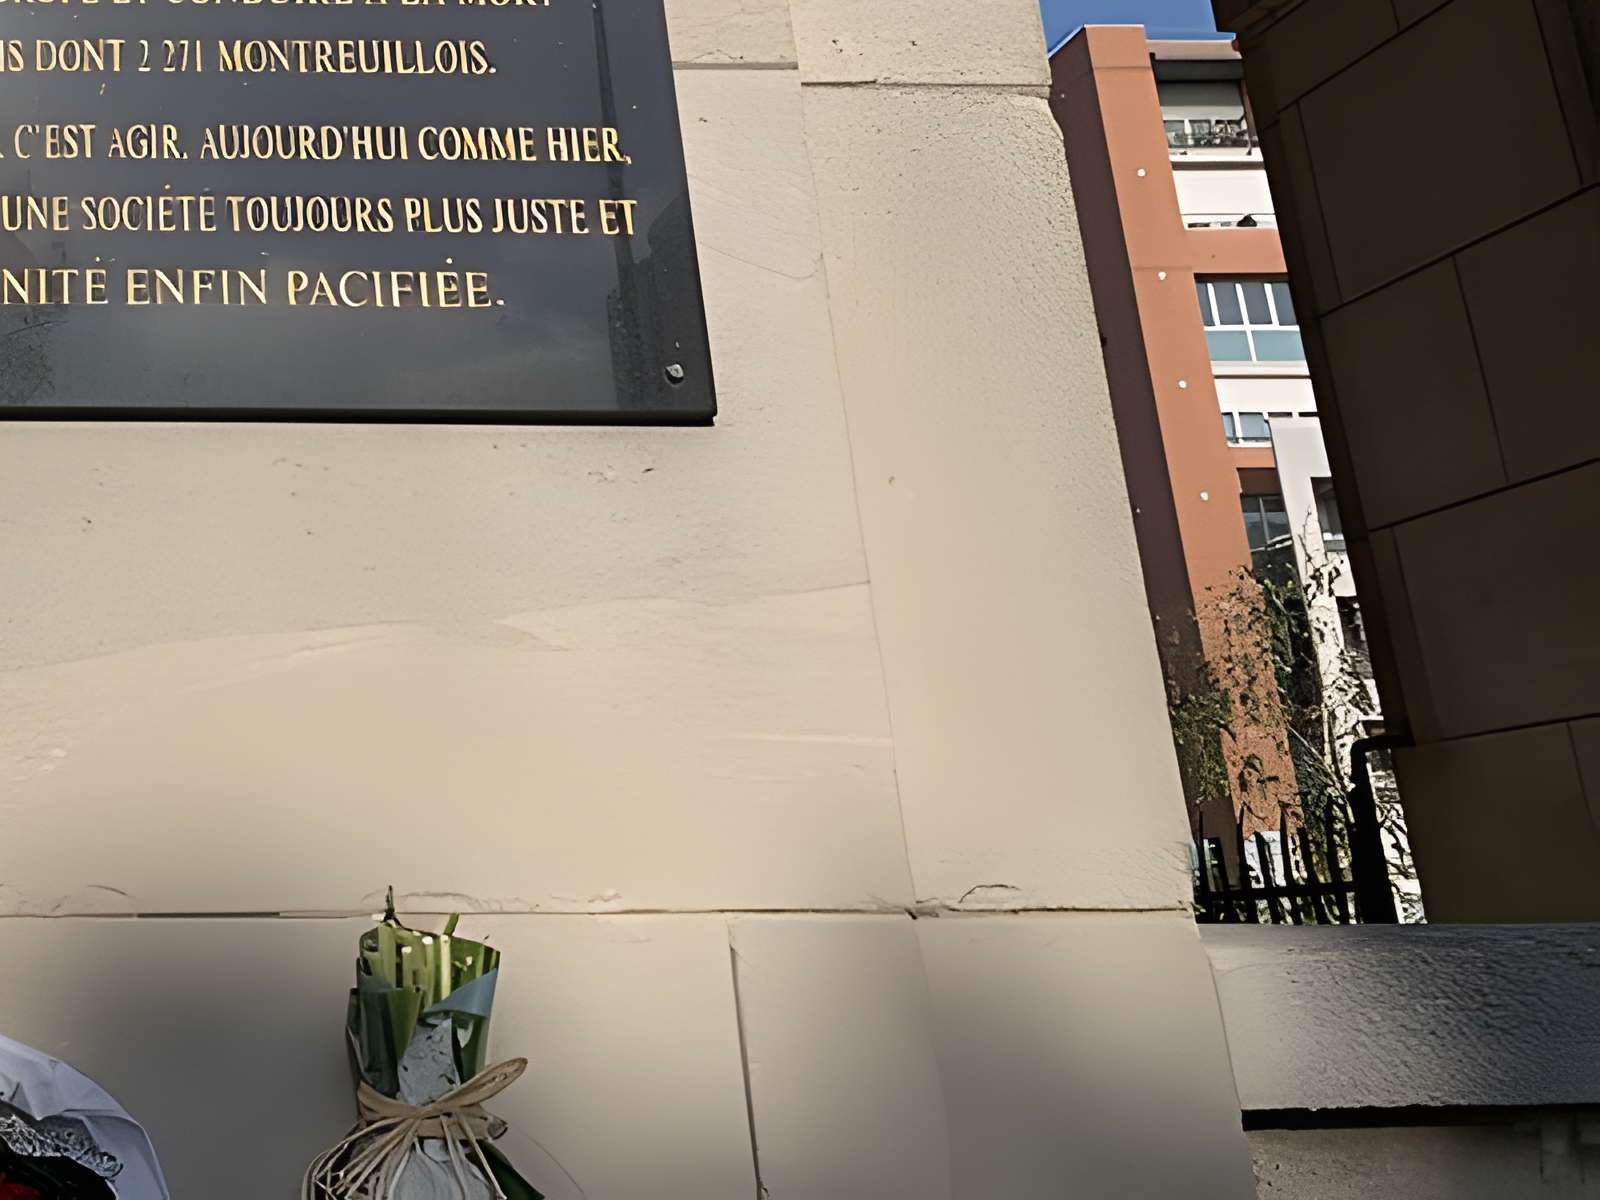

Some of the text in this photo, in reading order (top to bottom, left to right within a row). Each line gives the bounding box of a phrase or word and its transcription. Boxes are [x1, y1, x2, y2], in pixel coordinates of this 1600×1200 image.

[35, 38, 127, 73] DONT
[217, 39, 497, 75] MONTREUILLOIS.
[13, 124, 97, 160] C'EST
[199, 124, 409, 161] AUJOURD'HUI
[417, 126, 537, 163] COMME
[0, 195, 70, 232] UNE
[224, 195, 395, 234] TOUJOURS
[404, 198, 483, 234] PLUS
[491, 198, 590, 235] JUSTE
[598, 199, 638, 237] ET
[125, 269, 268, 306] ENFIN
